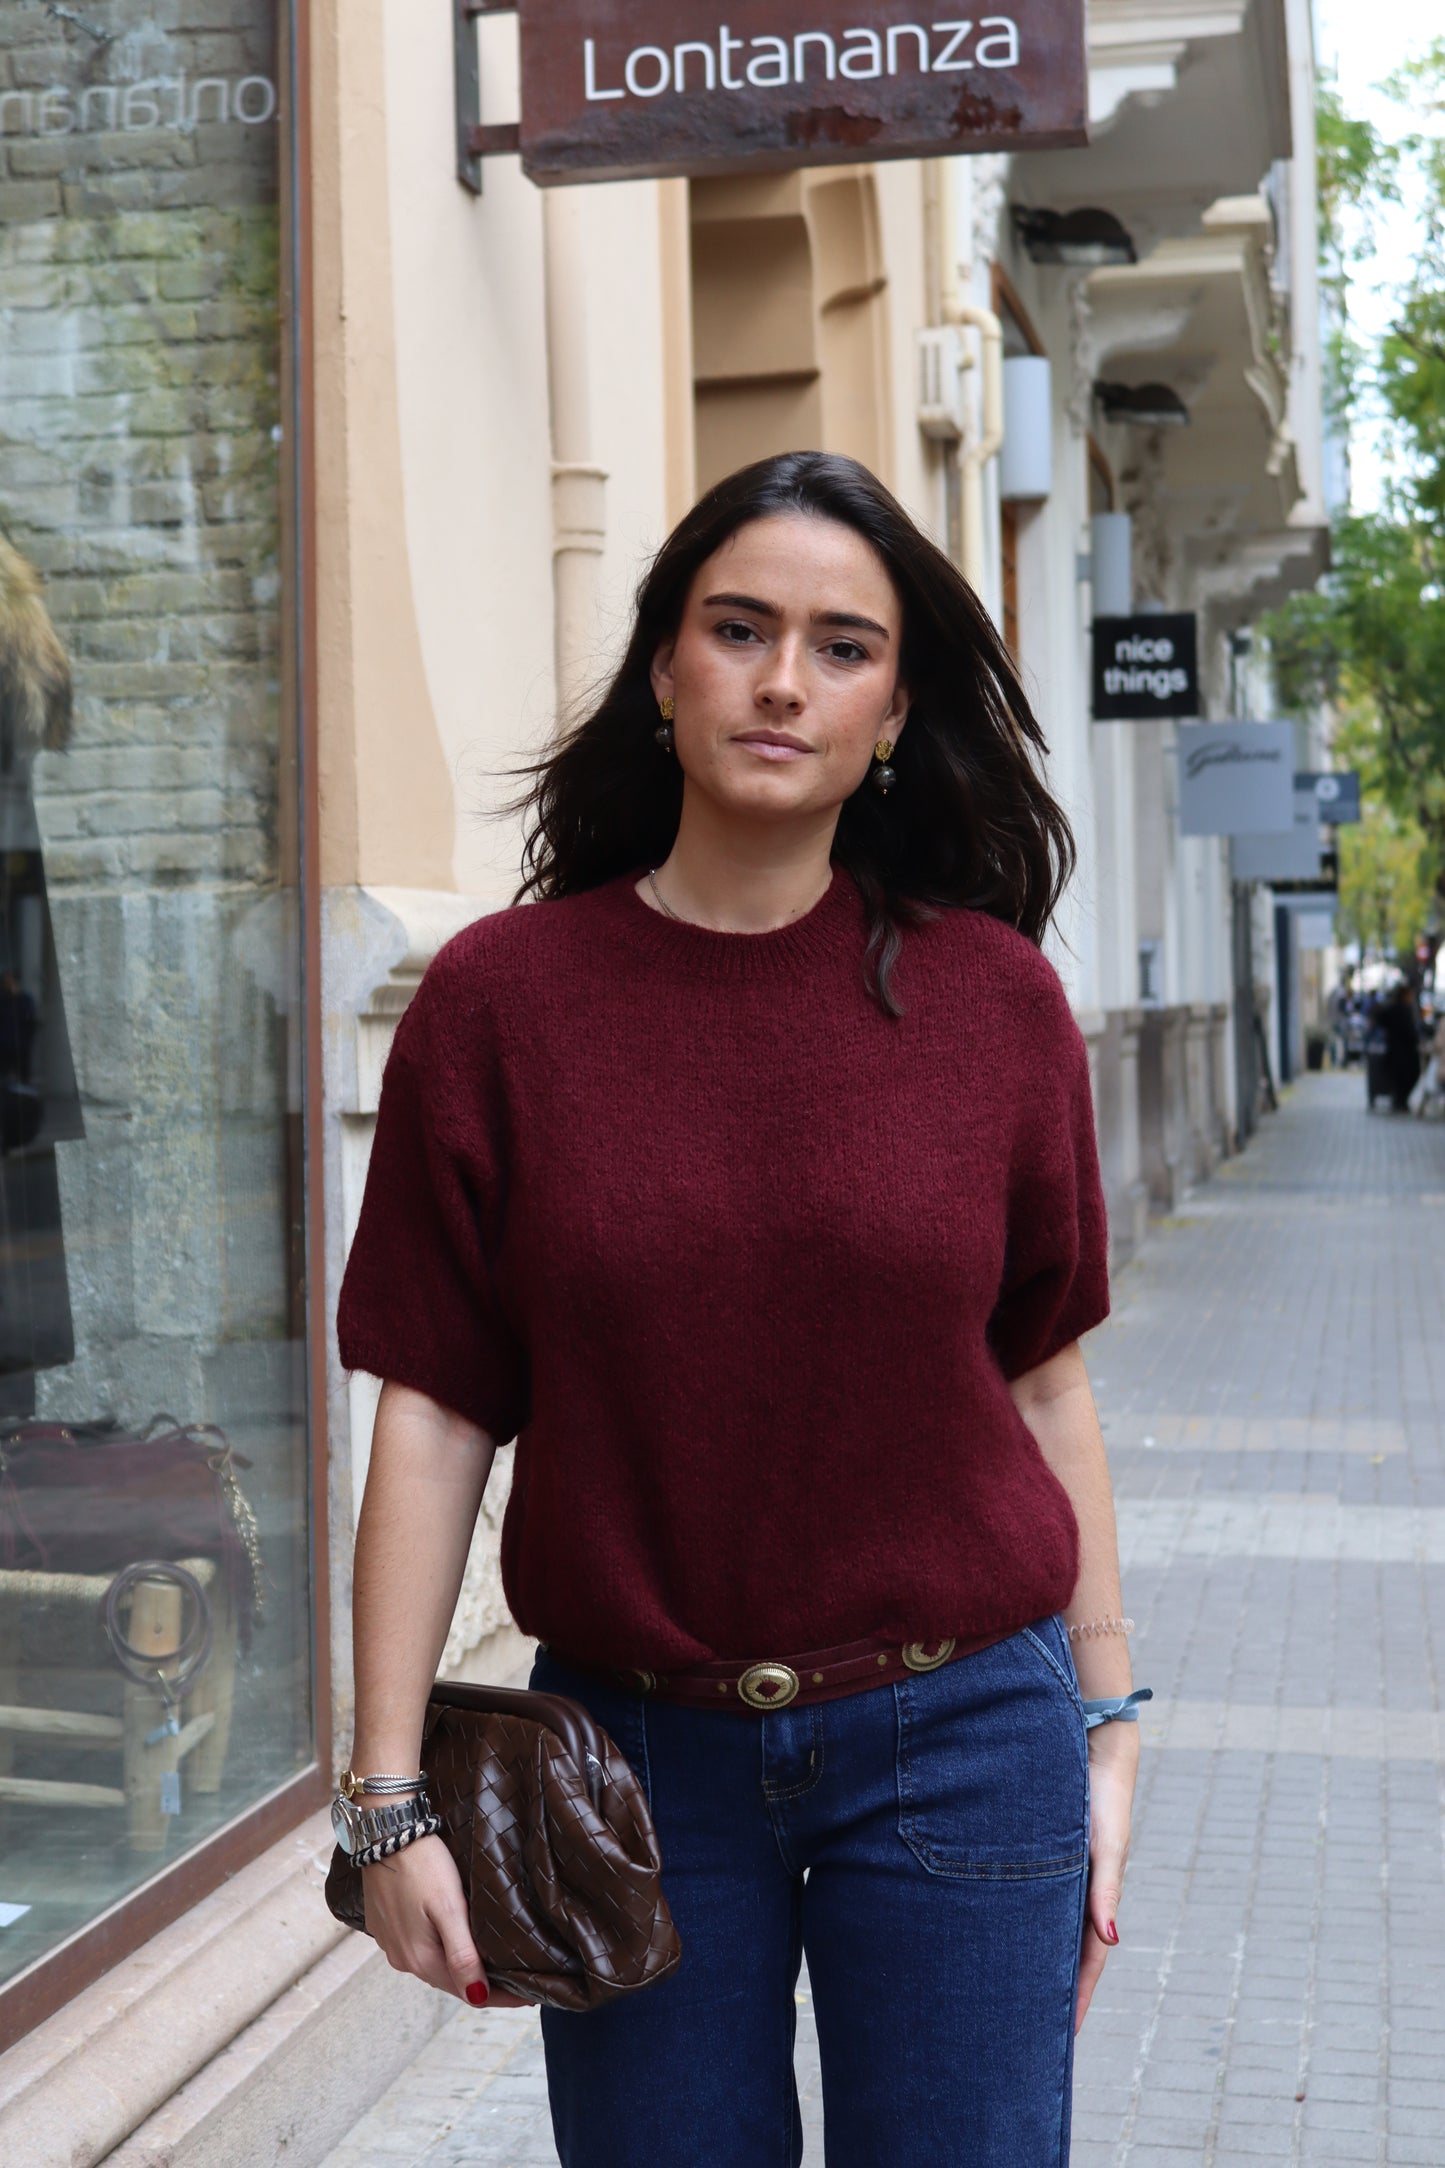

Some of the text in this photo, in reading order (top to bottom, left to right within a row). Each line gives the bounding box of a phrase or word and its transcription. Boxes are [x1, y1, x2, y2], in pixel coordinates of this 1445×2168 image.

[583, 15, 1021, 101] Lontananza
[1115, 635, 1174, 662] nice
[1104, 666, 1188, 699] things
